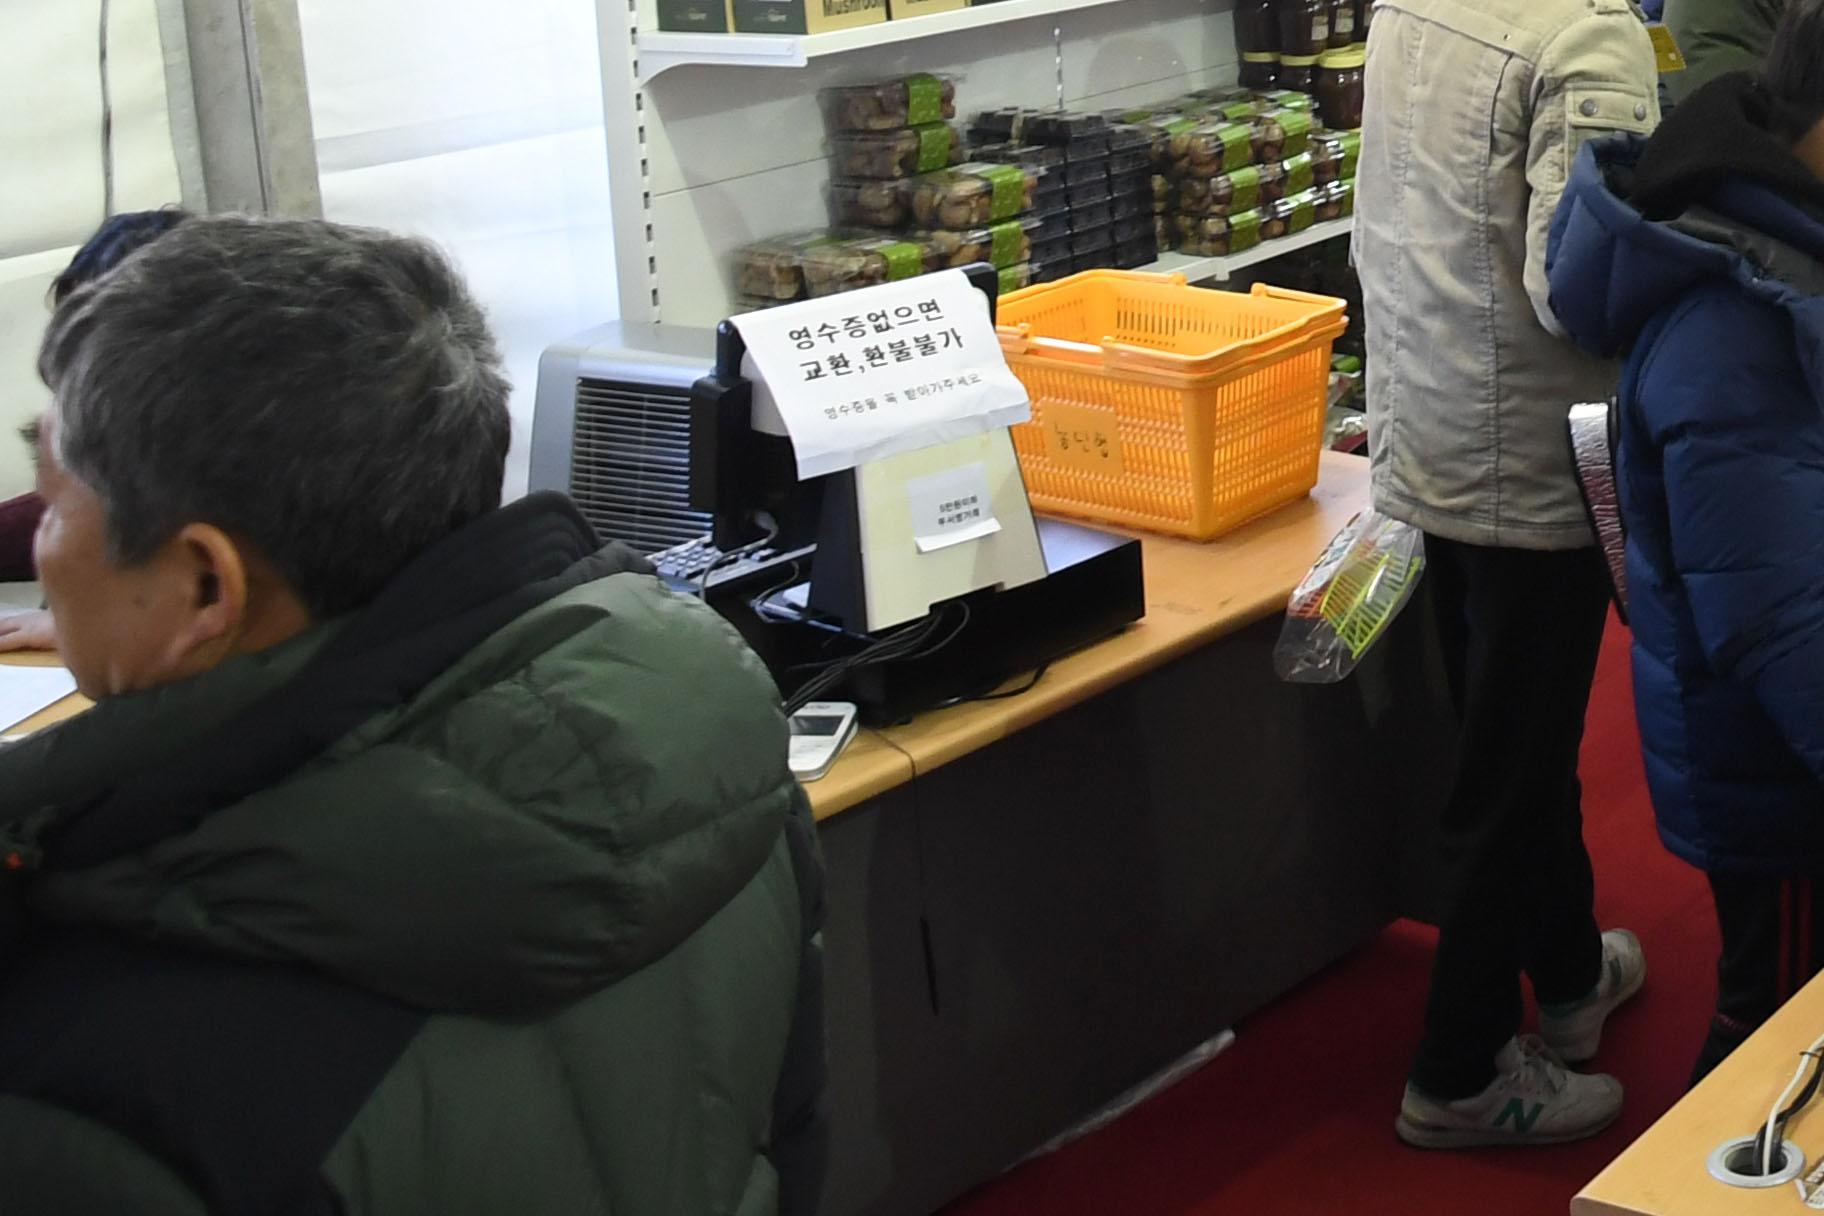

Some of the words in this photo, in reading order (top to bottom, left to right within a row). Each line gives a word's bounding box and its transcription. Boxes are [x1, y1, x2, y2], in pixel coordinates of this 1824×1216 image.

[788, 298, 944, 351] 영수증없으면
[799, 327, 964, 382] 교환,환불불가
[823, 397, 878, 420] 영수증을
[904, 373, 982, 401] 받아가주세요
